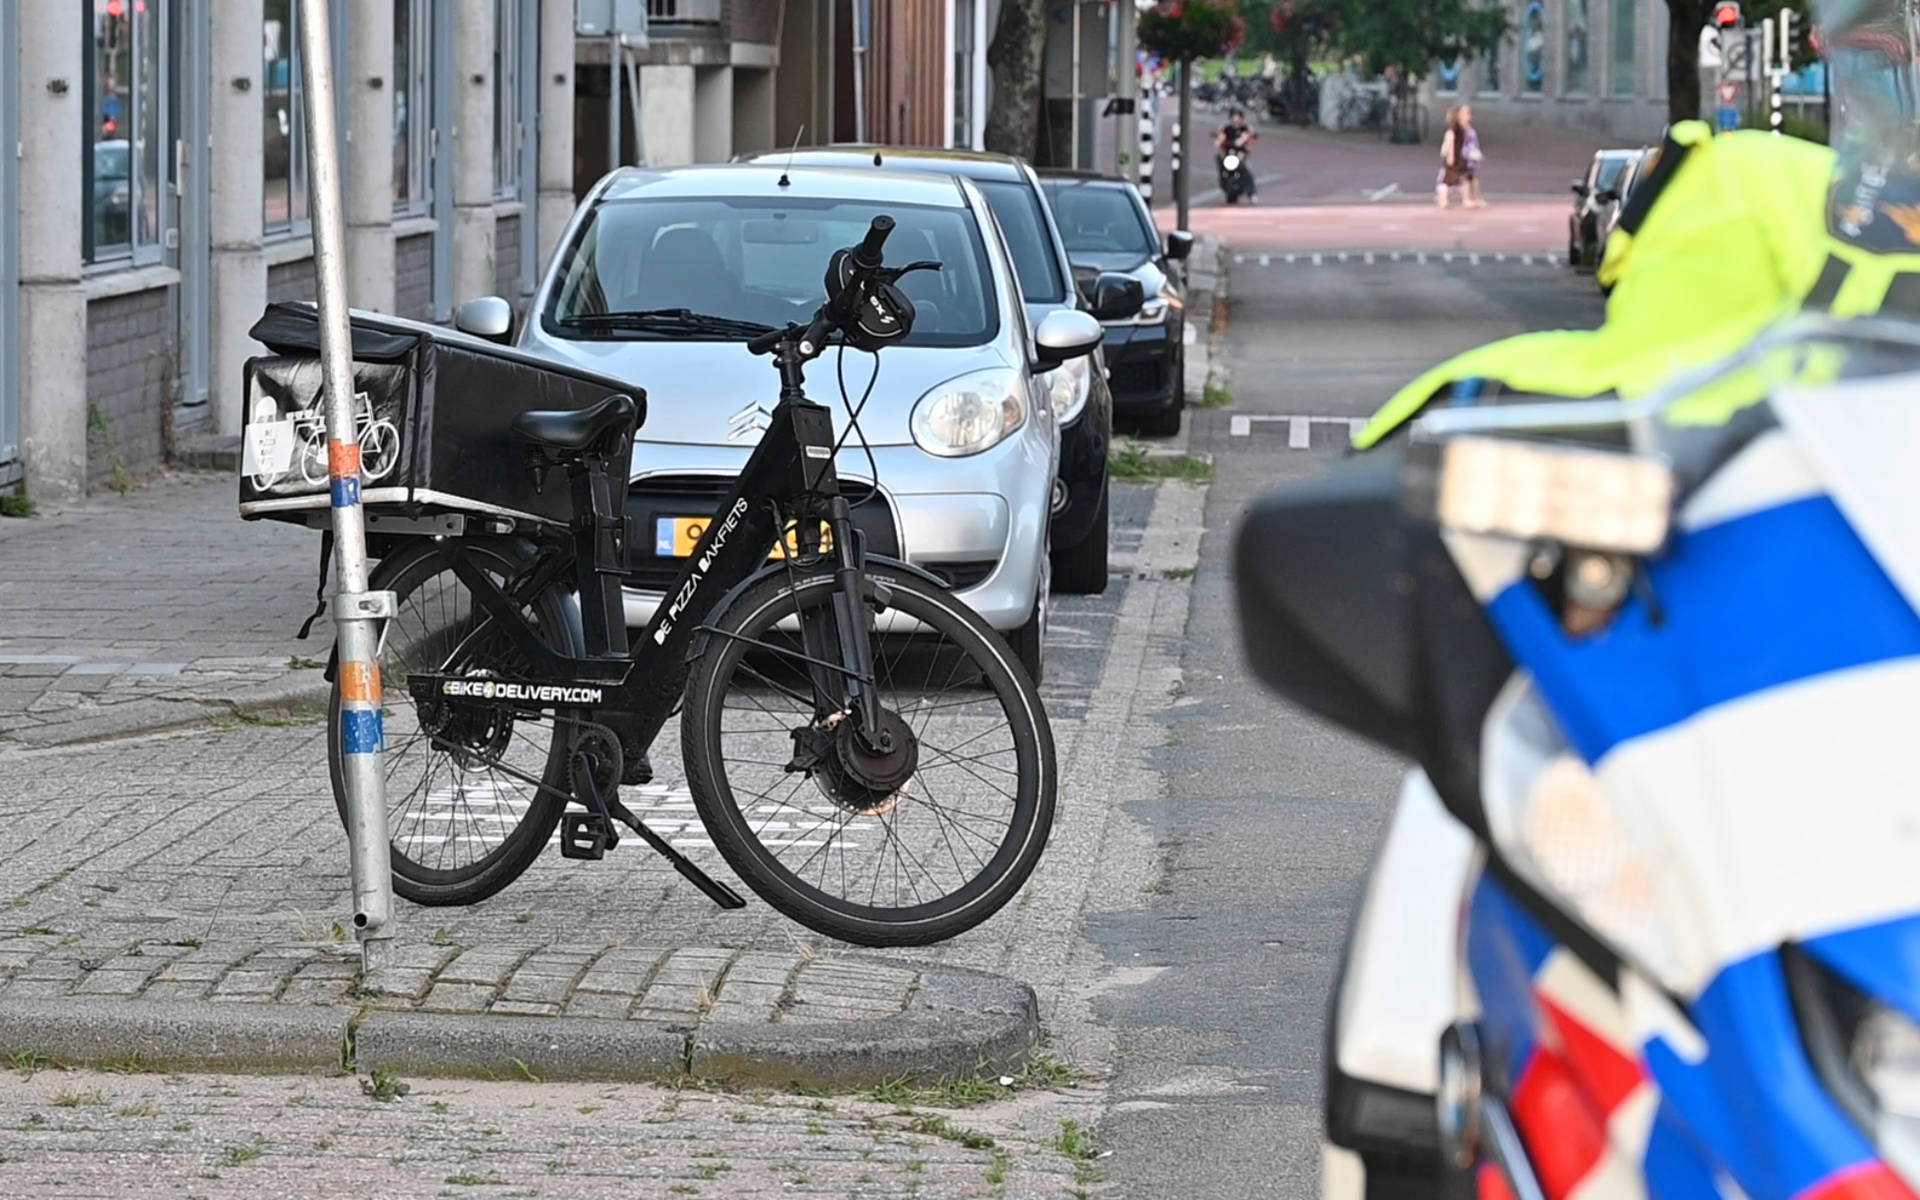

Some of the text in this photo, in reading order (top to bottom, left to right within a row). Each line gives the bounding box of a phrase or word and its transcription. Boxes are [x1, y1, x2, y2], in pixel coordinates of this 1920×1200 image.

[653, 497, 749, 646] DE PIZZA BAKFIETS
